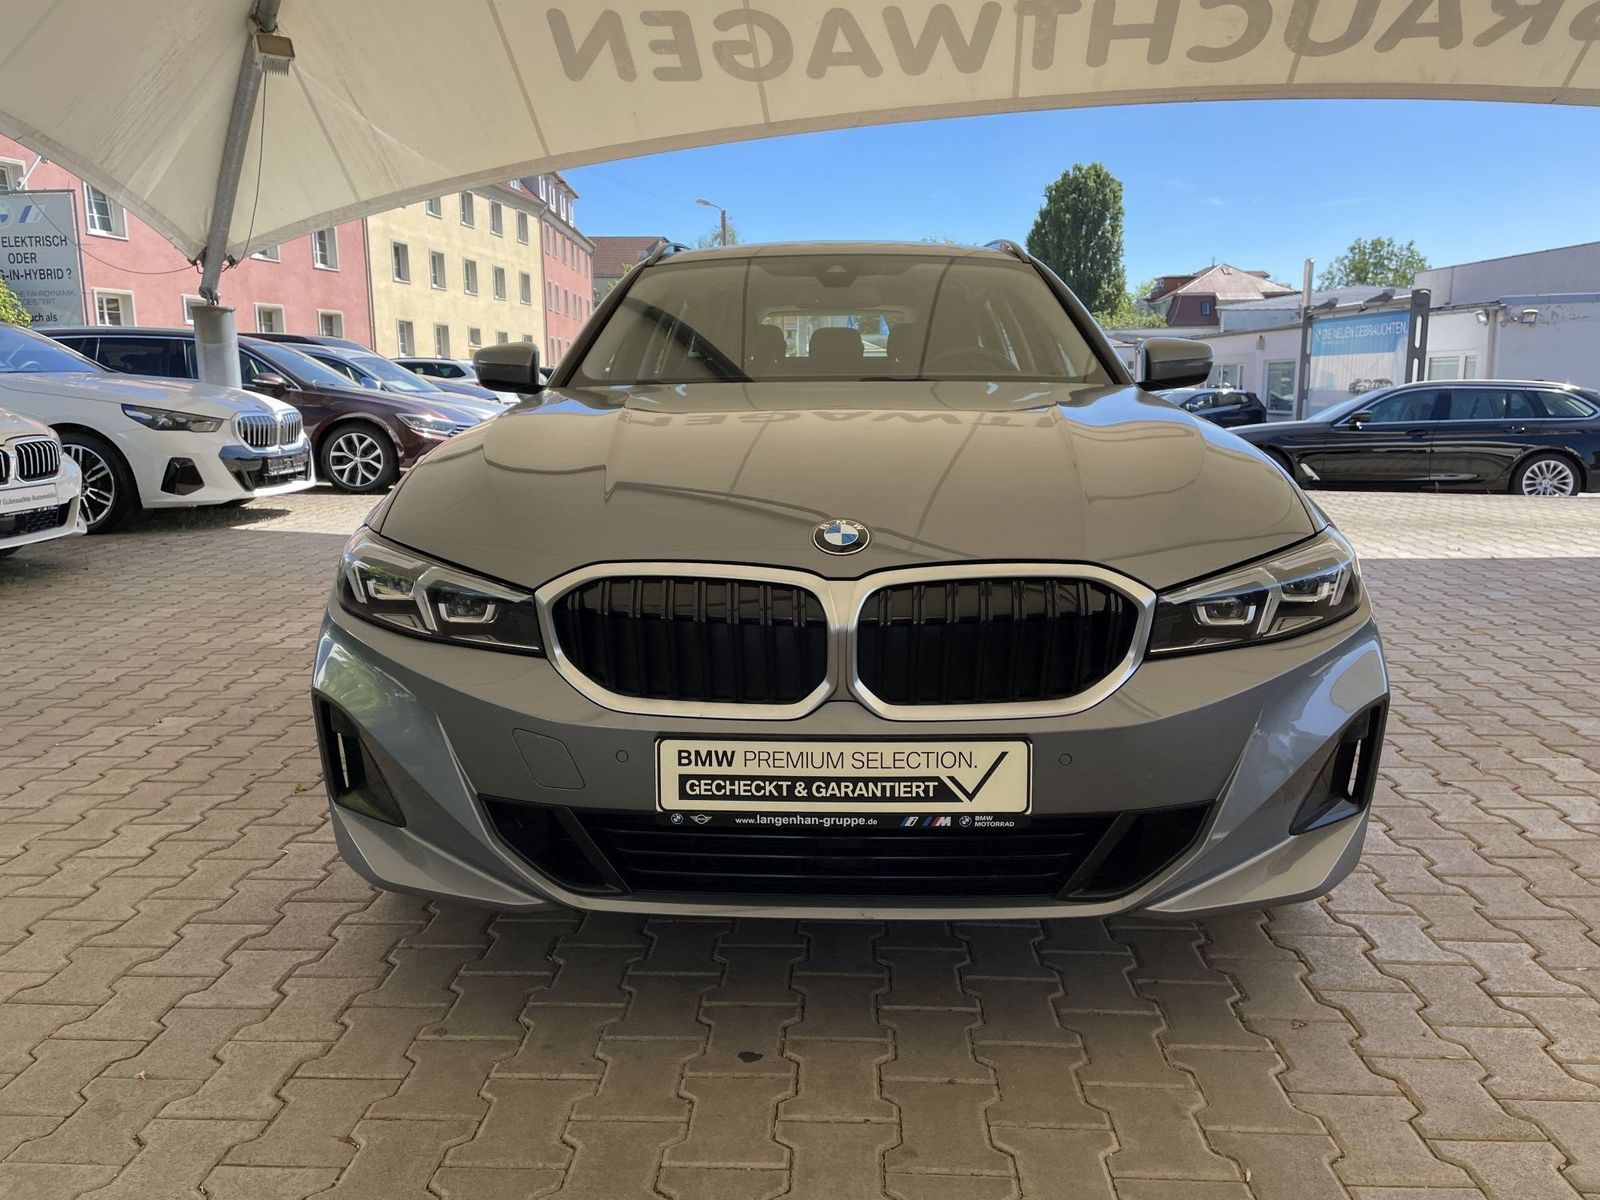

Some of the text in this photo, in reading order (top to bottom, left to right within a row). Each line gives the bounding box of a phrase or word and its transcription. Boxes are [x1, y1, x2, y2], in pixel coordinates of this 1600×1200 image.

[1, 235, 68, 248] ELEKTRISCH
[8, 252, 38, 264] ODER
[677, 749, 978, 770] BMW PREMIUM SELECTION.
[685, 779, 939, 798] GECHECKT & GARANTIERT
[735, 814, 878, 827] www.langenhan-gruppe.de
